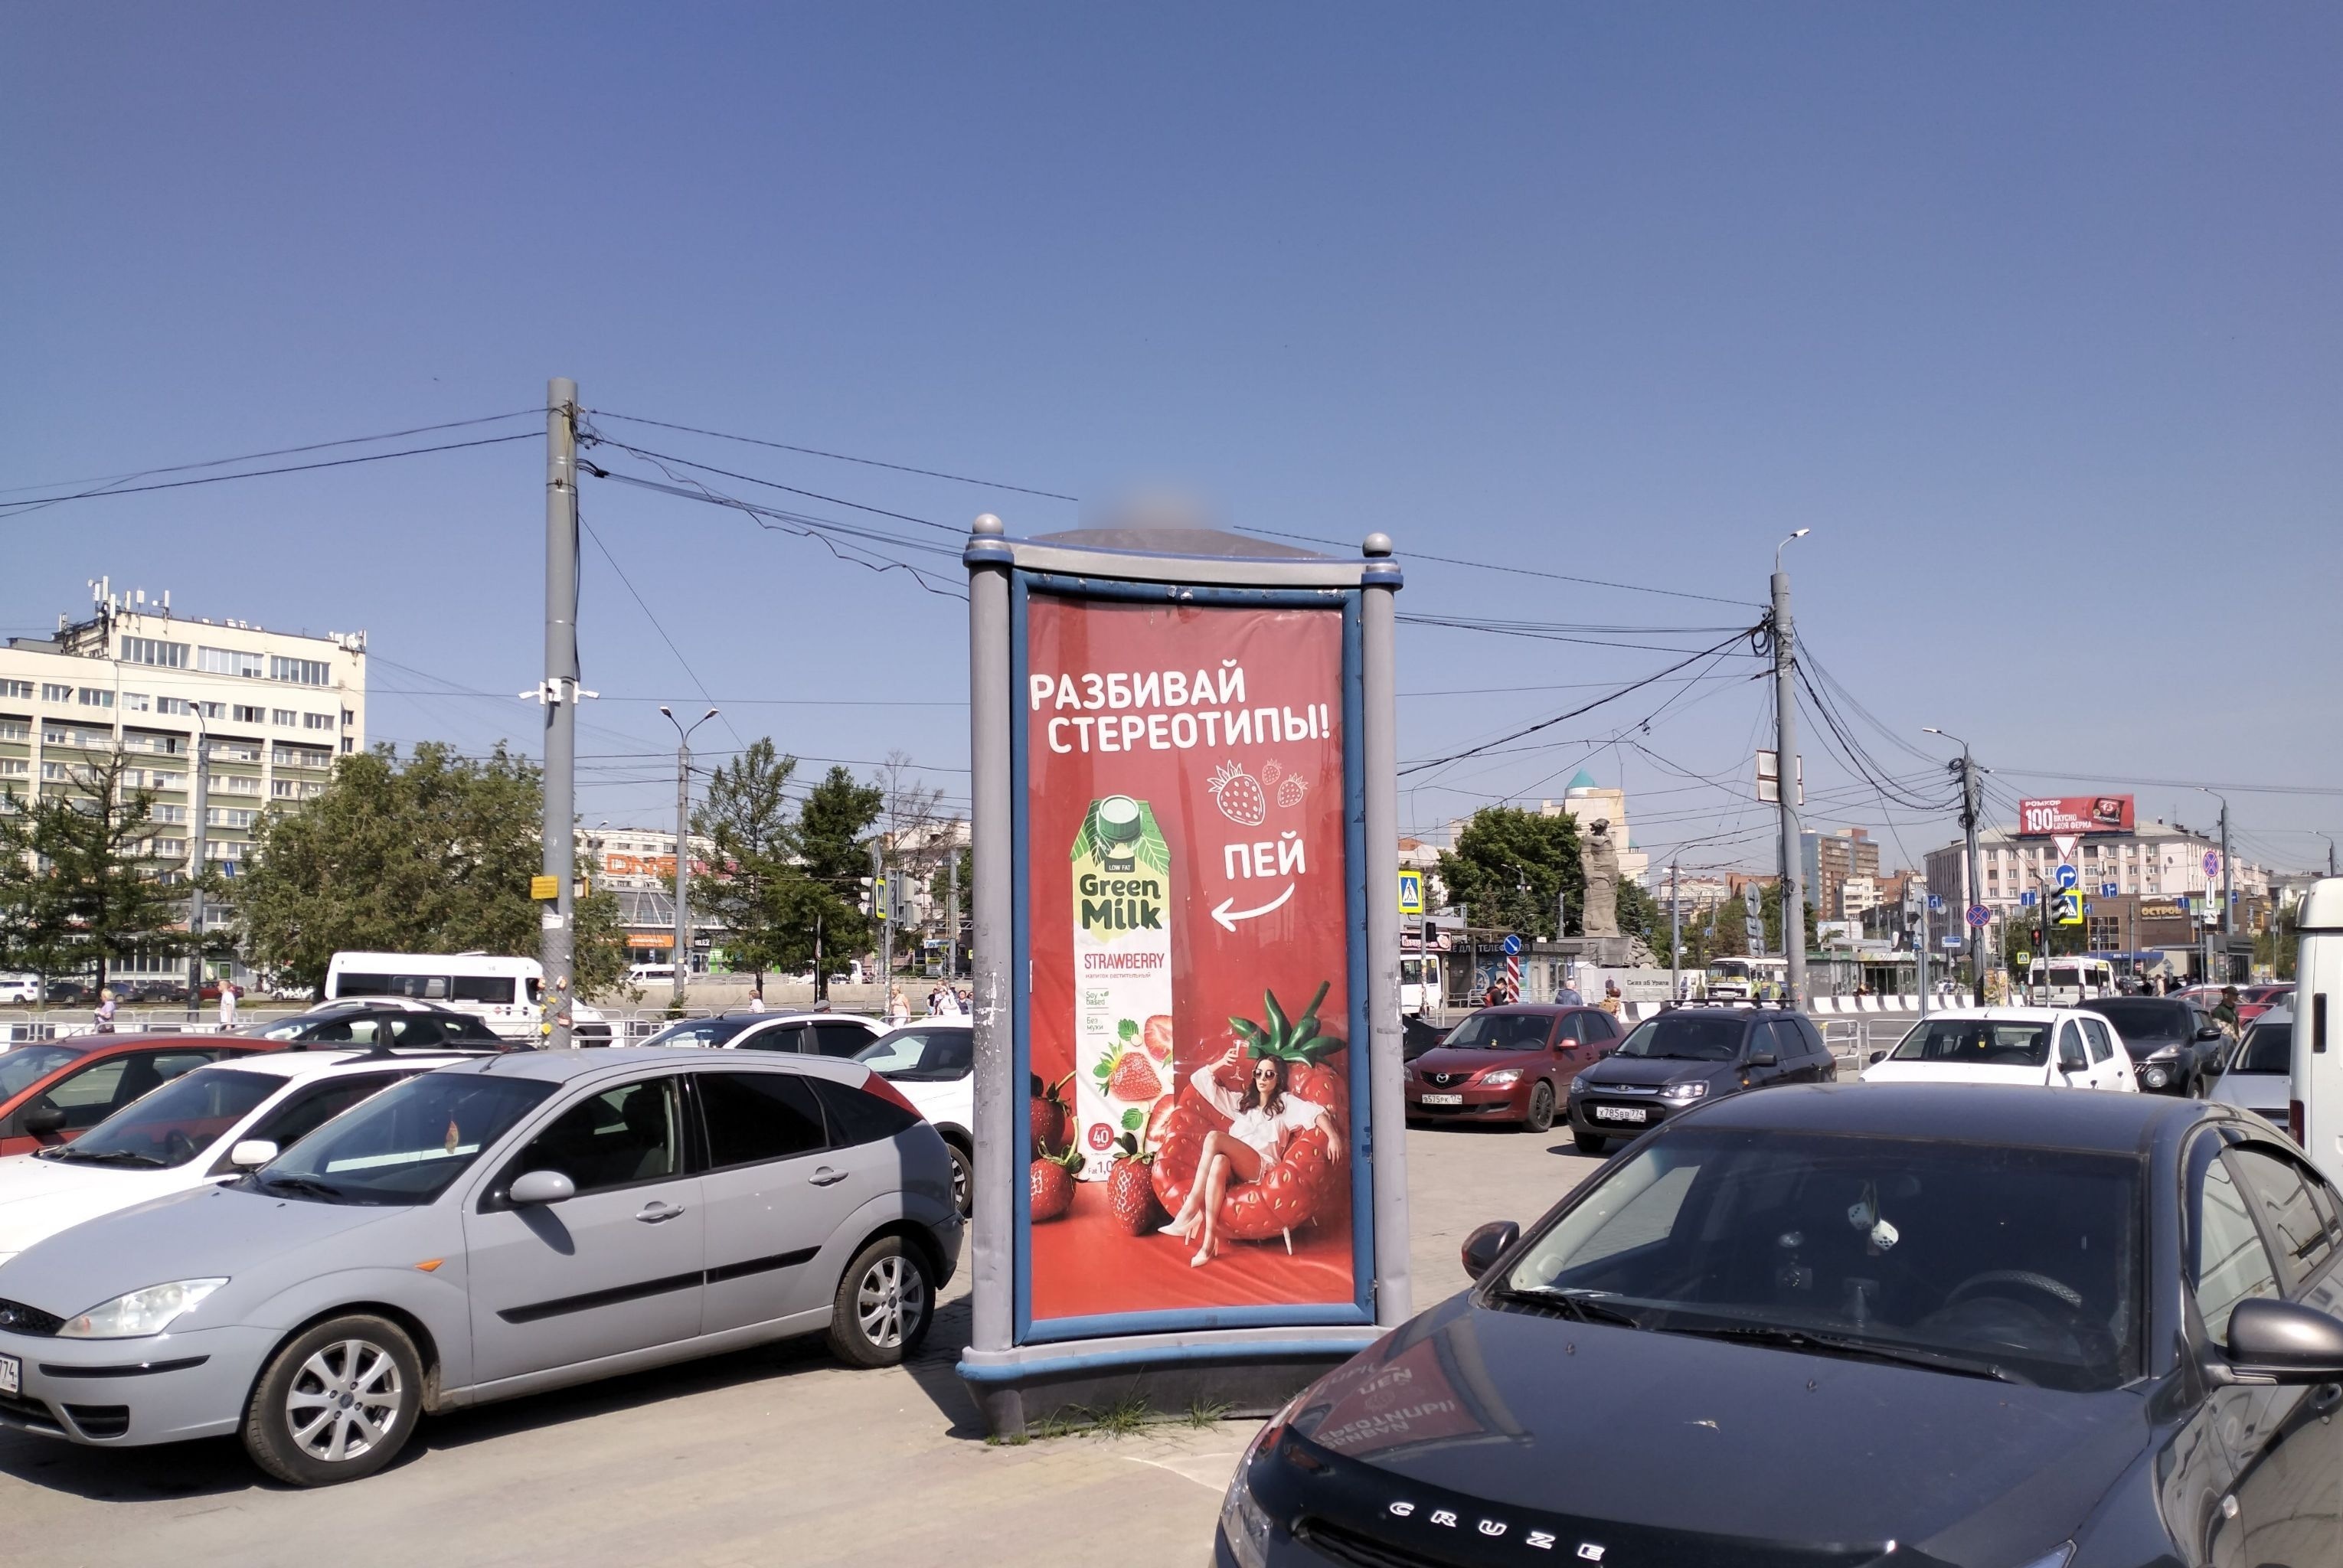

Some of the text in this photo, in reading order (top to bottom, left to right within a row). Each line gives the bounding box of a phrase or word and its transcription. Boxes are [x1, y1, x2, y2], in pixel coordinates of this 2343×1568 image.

[1030, 658, 1246, 710] РАЗБИВАЙ
[1048, 703, 1330, 753] СТЕРЕОТИПЫ!
[2054, 814, 2077, 822] ВКУСНО
[2070, 821, 2092, 829] ФЕРМА
[1224, 830, 1306, 880] ПЕЙ
[1080, 874, 1161, 900] Green
[1081, 898, 1162, 929] Milk
[1478, 944, 1530, 952] ТЕЛЕФОВ
[1084, 953, 1165, 969] STRAWBERRY
[1086, 991, 1098, 1000] Soy
[1093, 1129, 1109, 1144] 40
[1389, 1501, 1606, 1561] CRUZE
